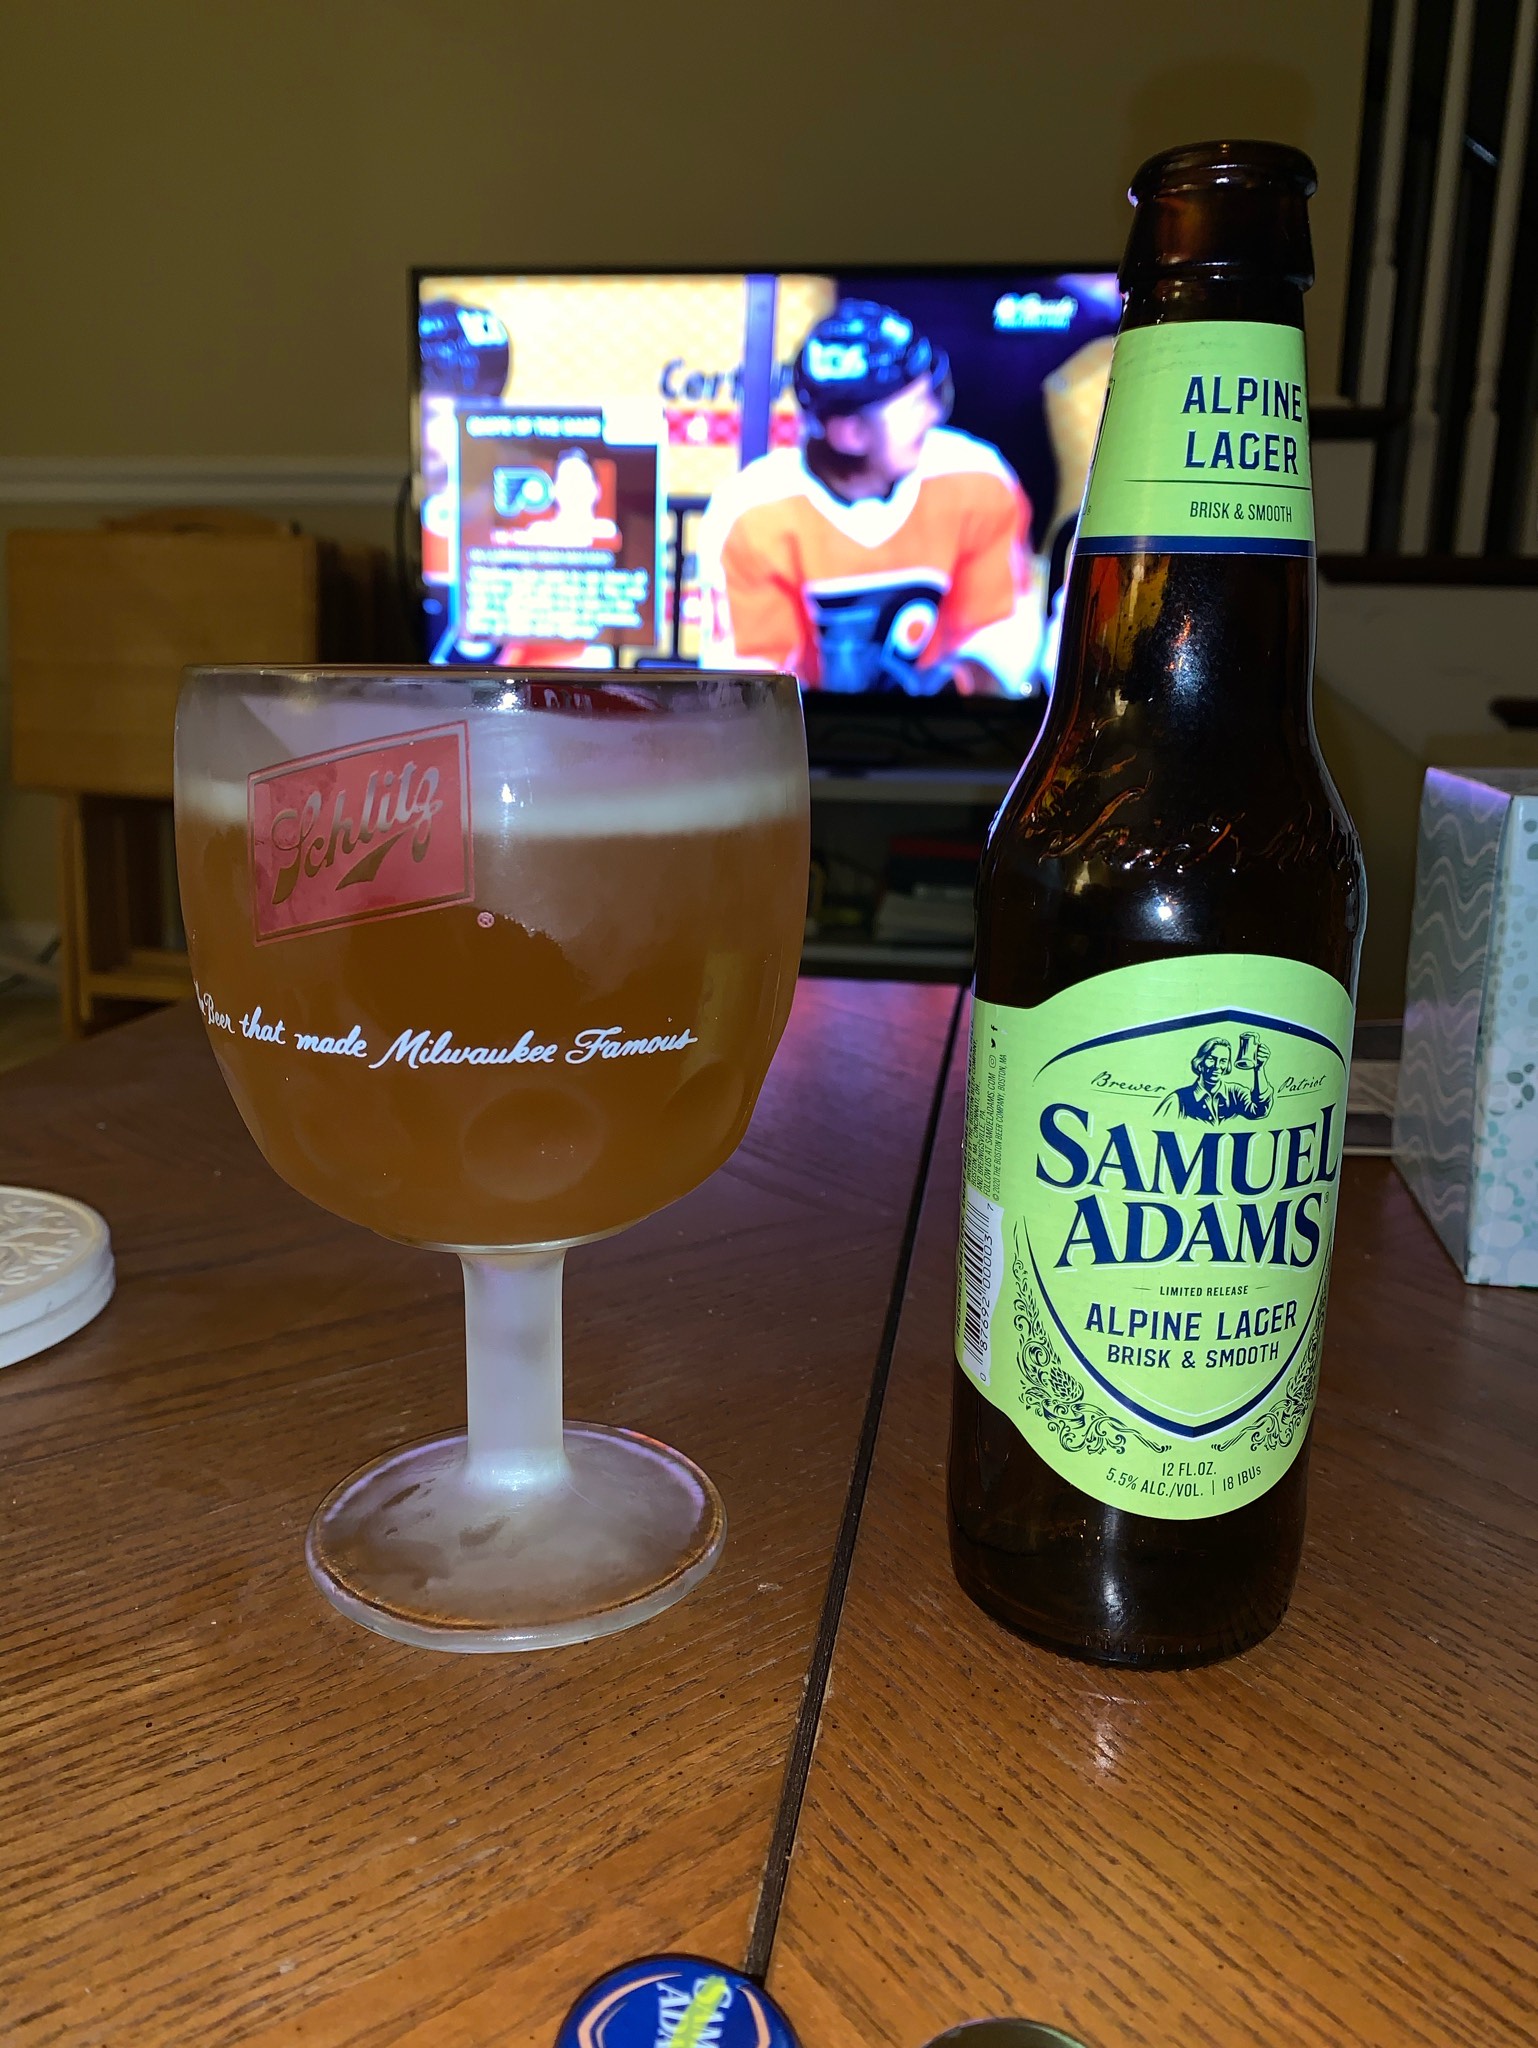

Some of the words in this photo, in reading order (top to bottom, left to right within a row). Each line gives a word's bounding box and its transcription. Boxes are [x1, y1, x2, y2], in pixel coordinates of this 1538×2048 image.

[1180, 375, 1303, 422] ALPINE
[1184, 430, 1299, 475] LAGER
[1190, 501, 1230, 520] BRISK
[1234, 507, 1244, 520] &
[1248, 503, 1293, 522] SMOOTH
[271, 760, 444, 905] Schlitz
[204, 992, 236, 1034] Beer
[239, 1006, 286, 1045] that
[294, 1024, 368, 1058] made
[368, 1028, 558, 1069] Milwaukee
[565, 1026, 698, 1065] Famous
[999, 1054, 1007, 1064] MA
[997, 1065, 1007, 1092] BOSTON,
[1090, 1070, 1168, 1093] Brewer
[1277, 1074, 1328, 1094] Patriot
[985, 1072, 996, 1146] SAMUELADAMS.COM
[996, 1092, 1006, 1123] COMPANY,
[995, 1123, 1003, 1140] BEER
[985, 1145, 992, 1156] AT
[985, 1156, 992, 1167] US
[994, 1139, 1002, 1165] BOSTON
[1036, 1103, 1340, 1196] SAMUEL
[983, 1167, 992, 1197] FOLLOW
[993, 1165, 1001, 1177] THE
[993, 1177, 1001, 1194] 2020
[986, 1203, 994, 1212] 7
[1053, 1192, 1323, 1268] ADAMS
[982, 1234, 993, 1289] 00003
[1159, 1285, 1203, 1297] LIMITED
[1206, 1285, 1249, 1297] RELEASE
[979, 1296, 990, 1351] 87692
[1084, 1302, 1202, 1342] ALPINE
[1216, 1299, 1298, 1341] LAGER
[1107, 1343, 1171, 1369] BRISK
[1181, 1350, 1196, 1369] &
[1205, 1340, 1280, 1369] SMOOTH
[980, 1372, 987, 1382] 0
[1105, 1467, 1139, 1490] 5.5%
[1140, 1479, 1204, 1498] ALC./VOL.
[1223, 1476, 1234, 1491] 18
[1237, 1465, 1262, 1486] IBUs
[1161, 1462, 1174, 1477] 12
[1178, 1461, 1217, 1477] FL.OZ.
